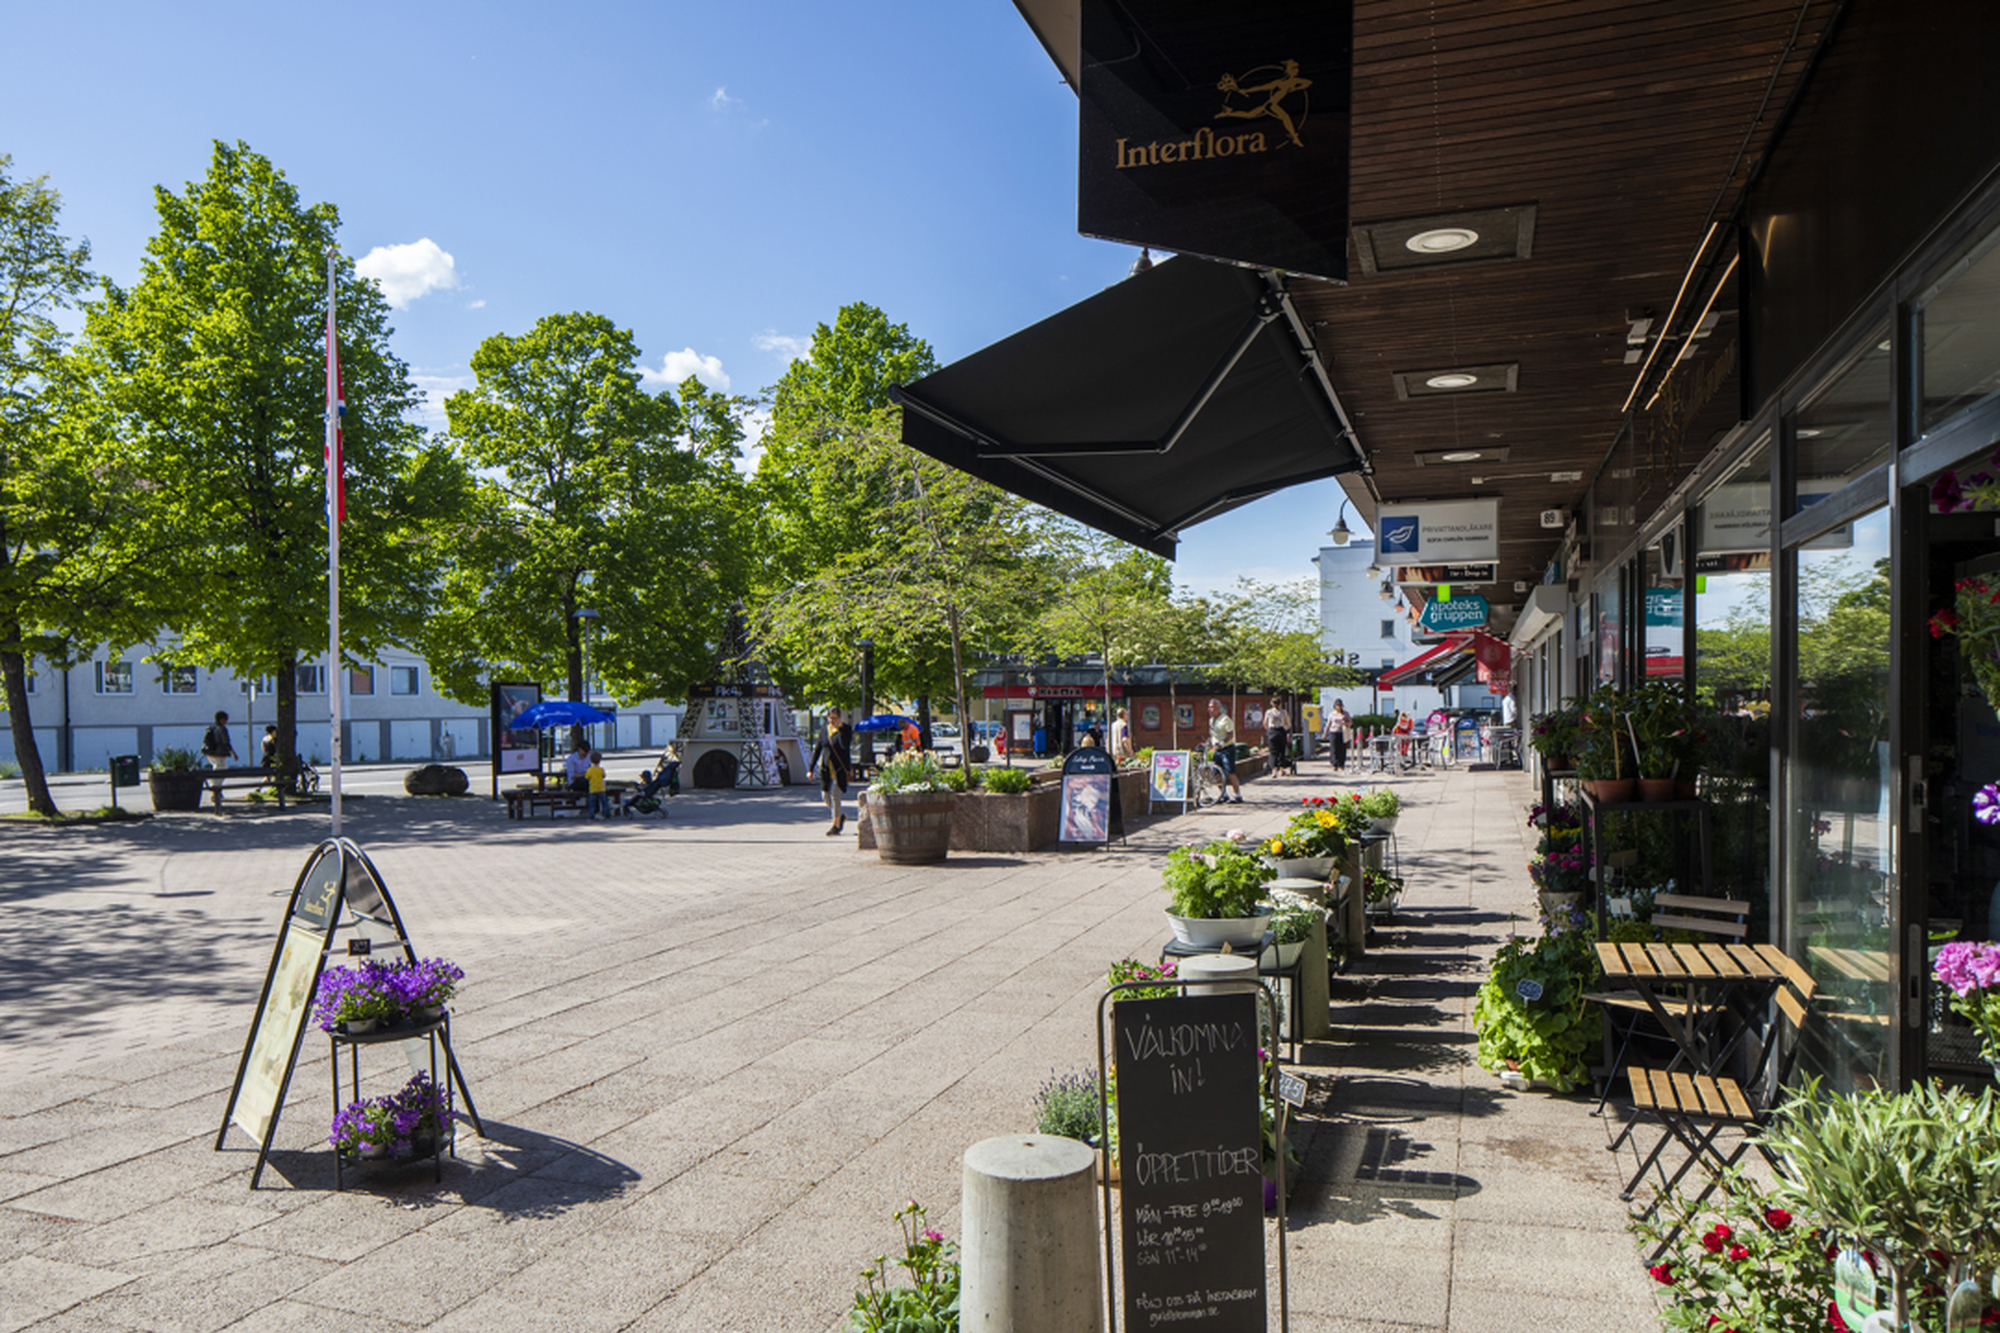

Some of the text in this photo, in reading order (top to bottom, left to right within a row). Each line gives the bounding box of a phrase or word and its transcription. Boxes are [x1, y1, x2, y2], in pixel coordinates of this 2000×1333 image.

[1115, 127, 1267, 170] Interflora
[1544, 512, 1556, 524] 89
[1422, 523, 1493, 533] PRIVATTANDLÄKARE
[1431, 600, 1480, 612] apoteks
[1430, 610, 1483, 623] gruppen
[1136, 1142, 1260, 1186] ÖPPETTIDER
[1166, 1296, 1184, 1307] OSS
